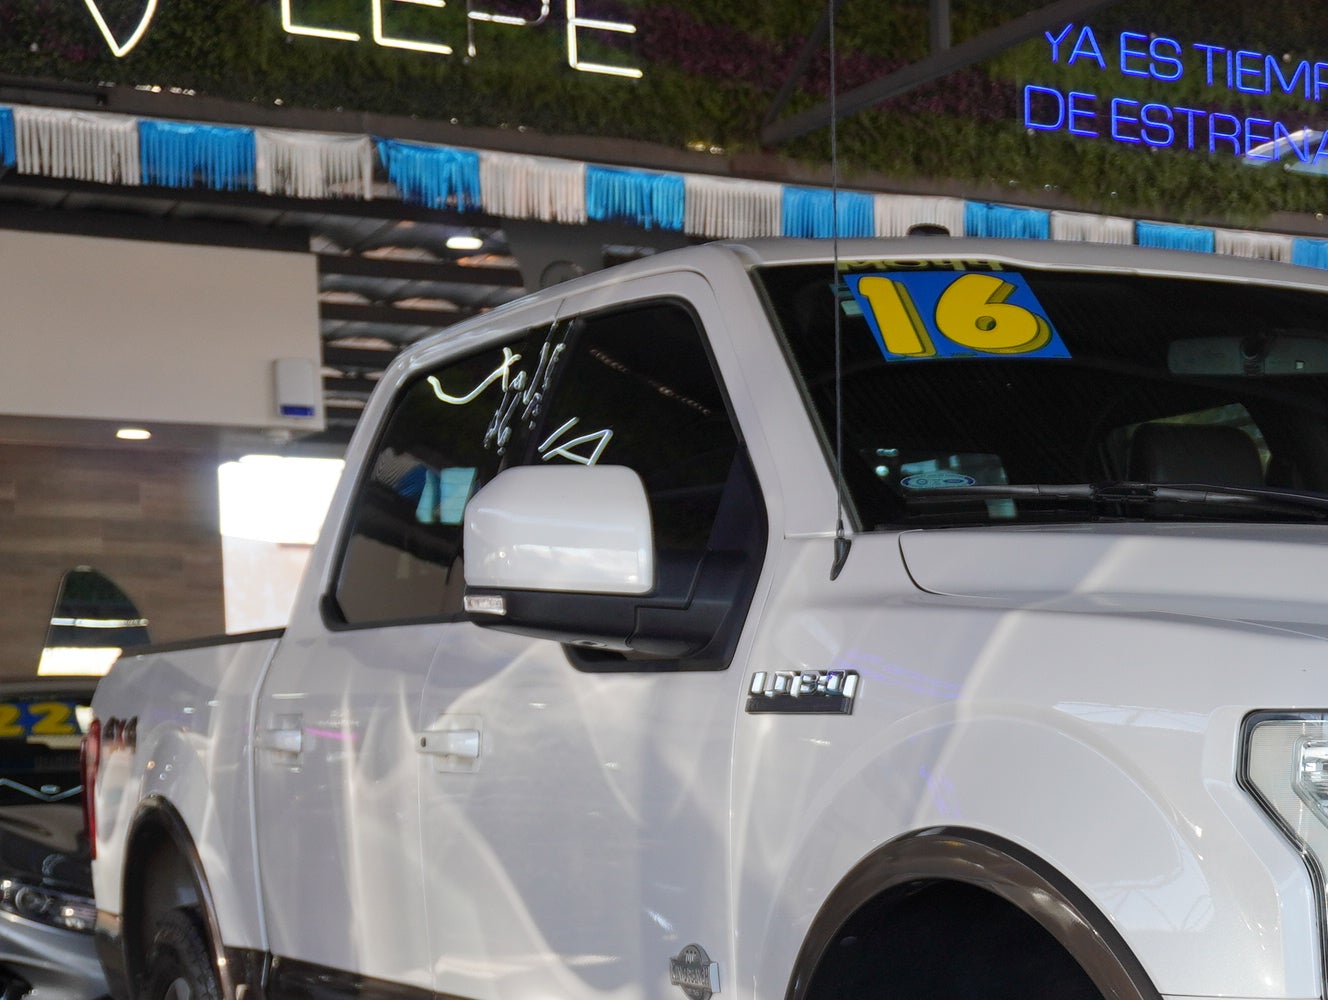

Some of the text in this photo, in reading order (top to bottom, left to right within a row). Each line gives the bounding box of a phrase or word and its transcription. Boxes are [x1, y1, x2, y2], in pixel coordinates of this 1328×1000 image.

[1044, 23, 1107, 70] YA
[1119, 31, 1185, 82] ES
[1024, 84, 1100, 138] DE
[857, 273, 1053, 358] 16
